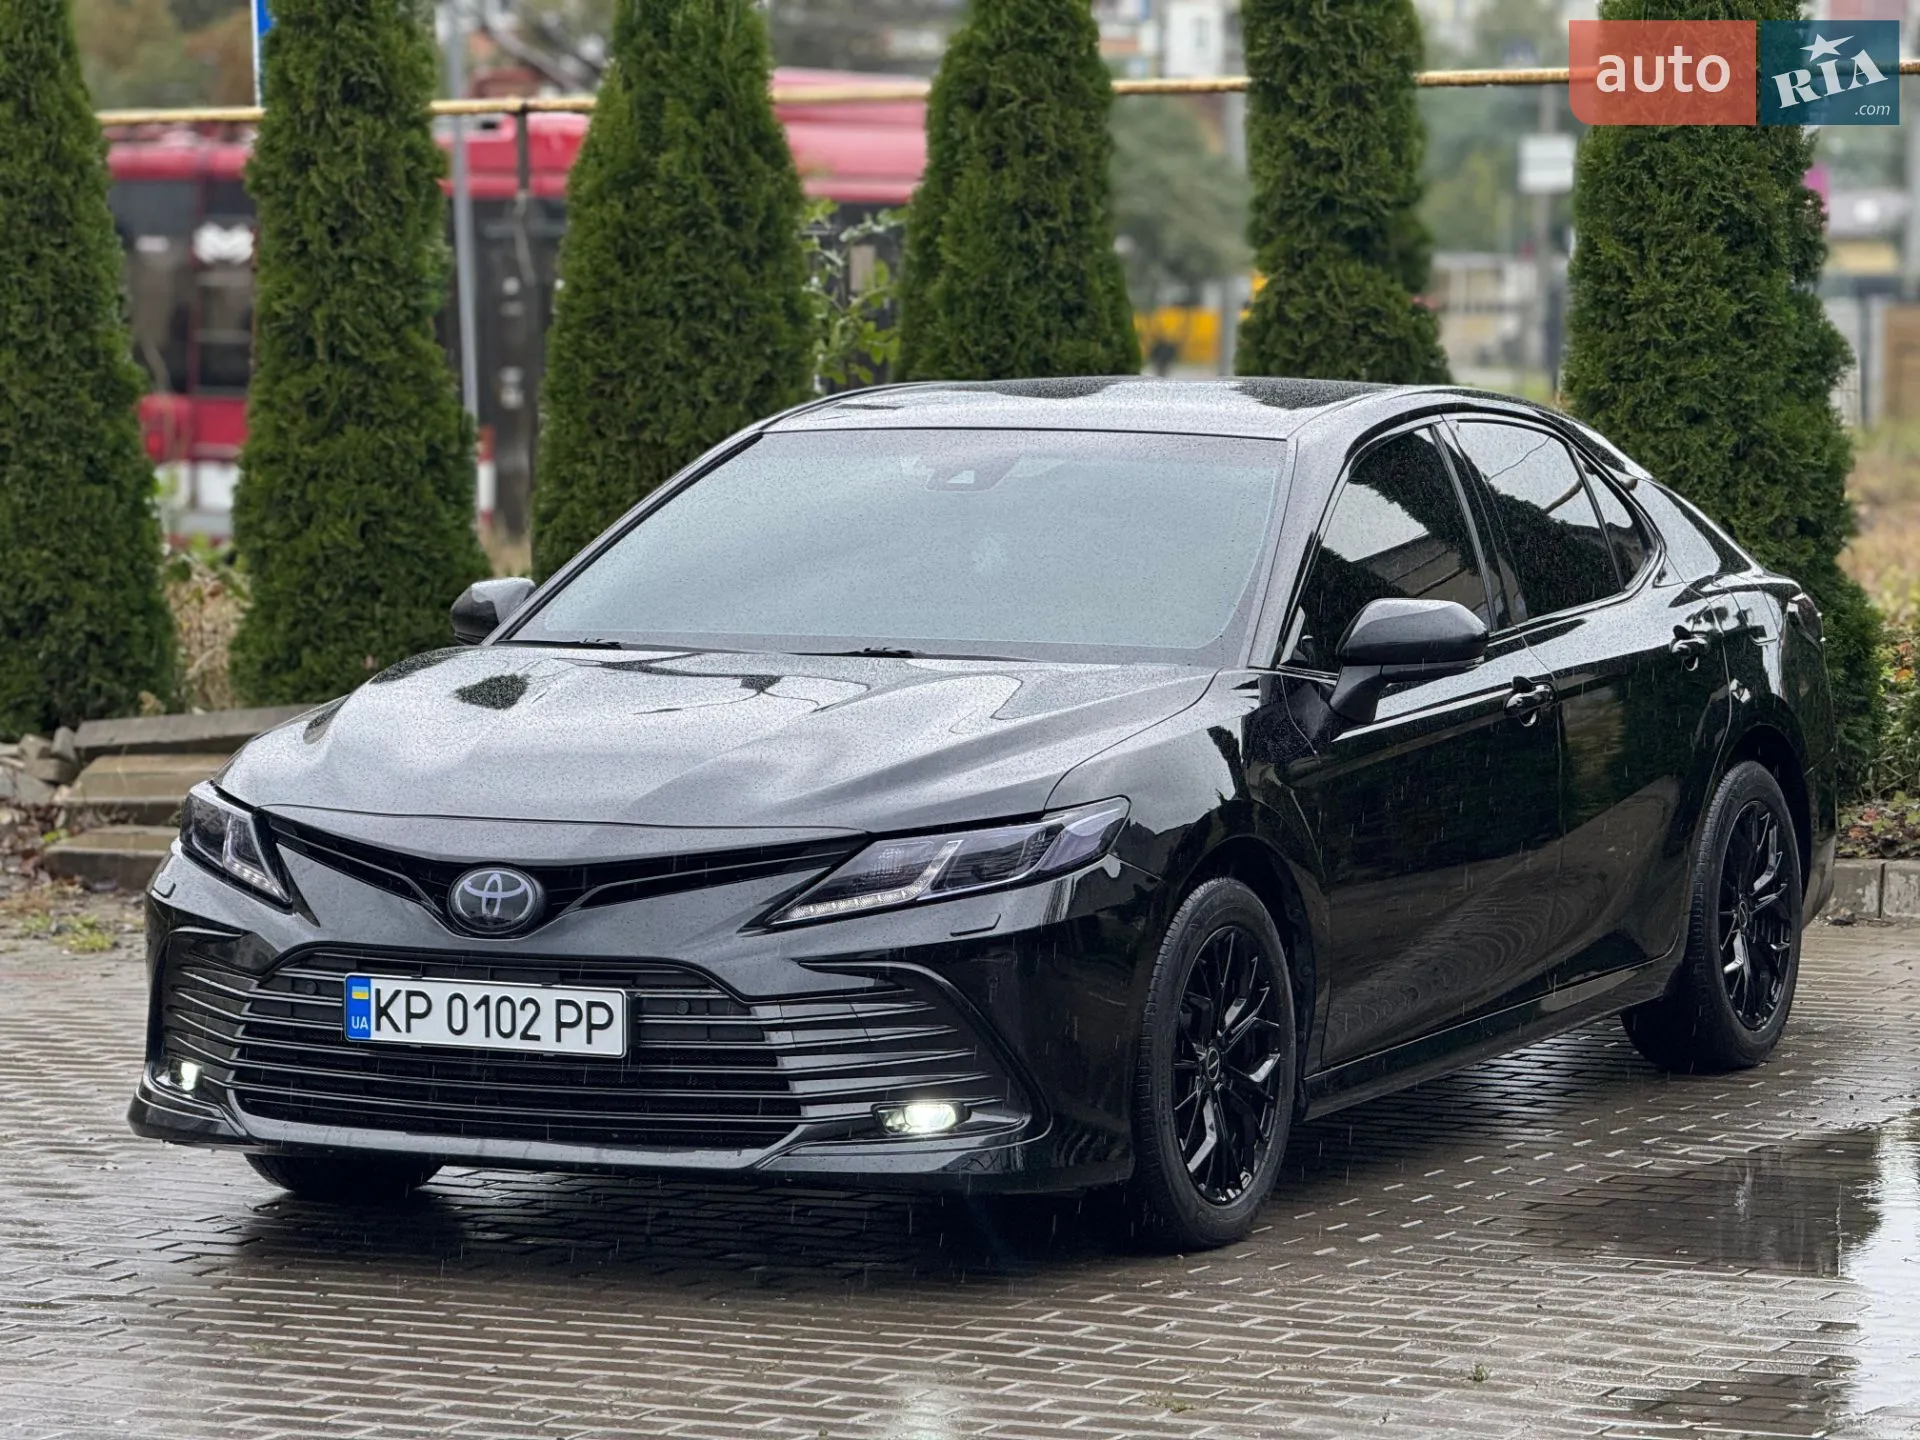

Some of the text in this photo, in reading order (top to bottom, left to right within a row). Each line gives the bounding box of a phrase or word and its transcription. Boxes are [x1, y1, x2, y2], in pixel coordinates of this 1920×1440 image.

[352, 1016, 369, 1030] UA
[375, 988, 614, 1045] KP 0102 PP
